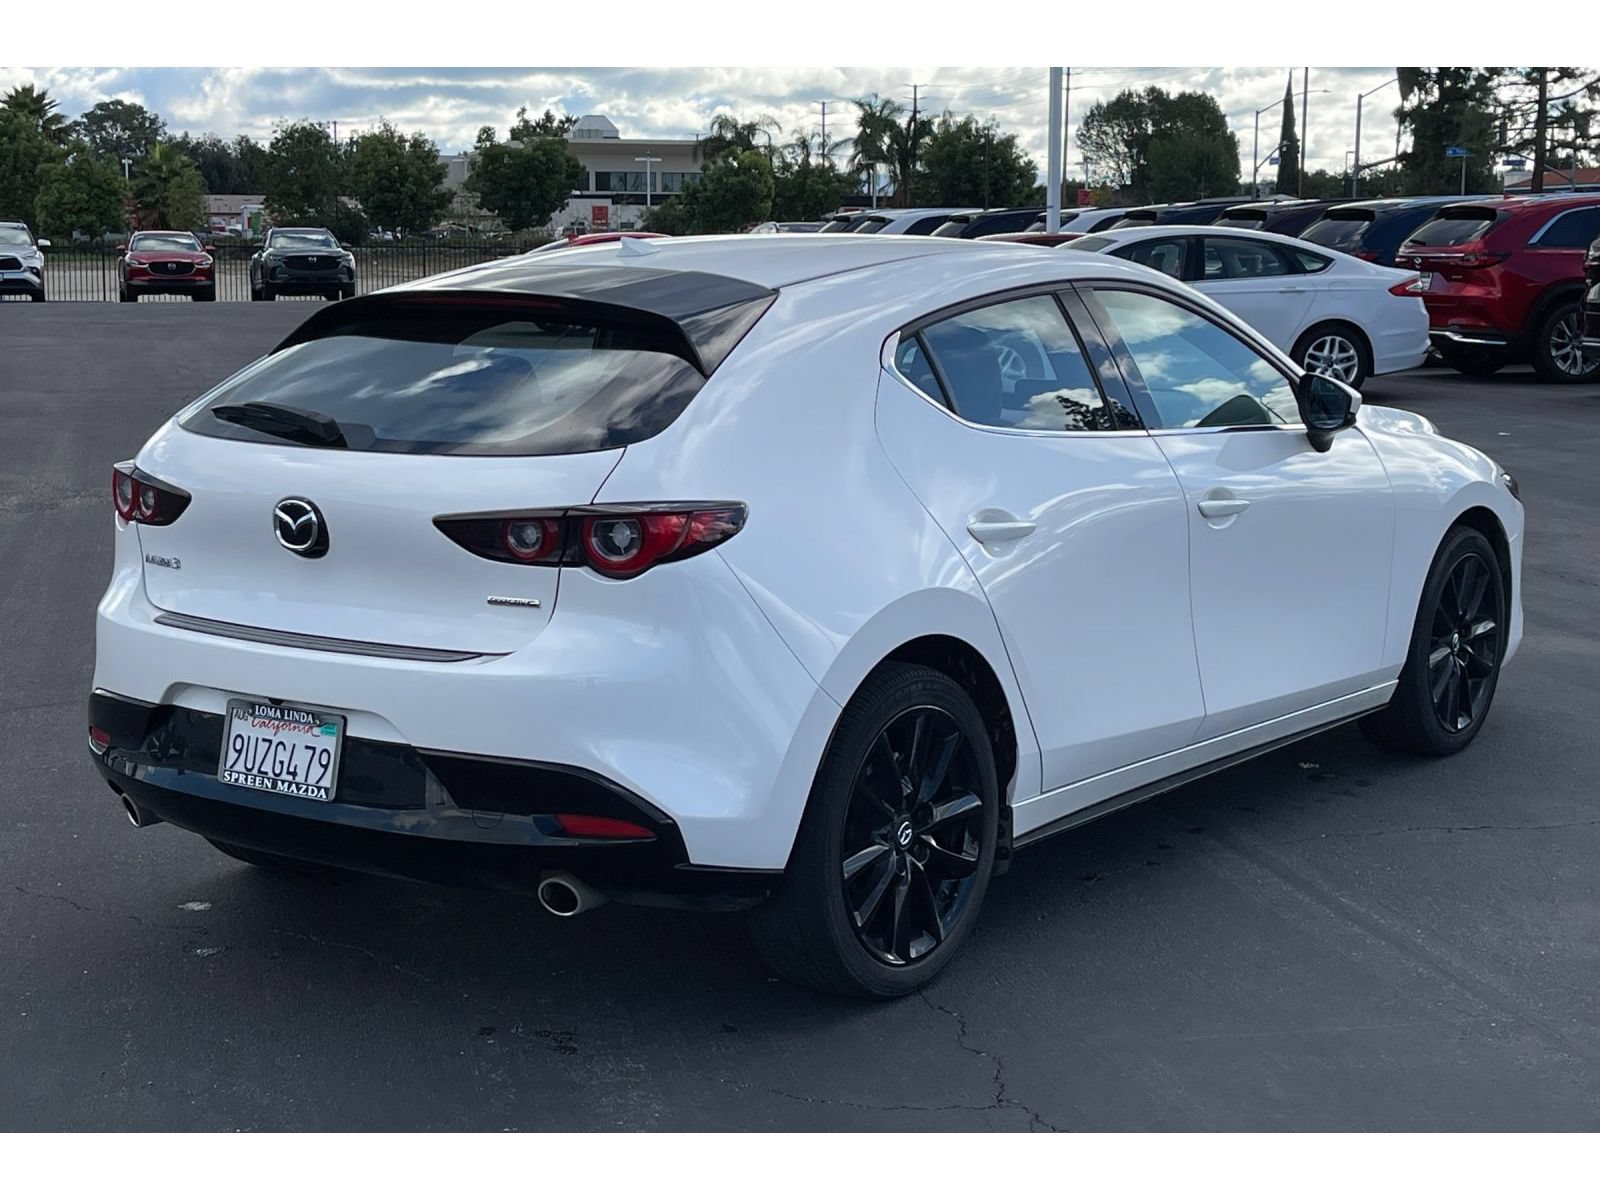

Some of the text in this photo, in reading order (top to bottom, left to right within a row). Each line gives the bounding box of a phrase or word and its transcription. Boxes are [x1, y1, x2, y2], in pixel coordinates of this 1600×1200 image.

[255, 705, 314, 723] LOMA LINDA
[251, 718, 321, 737] California
[229, 733, 331, 784] 9UZG479
[223, 771, 327, 798] SPREEN MAZDA
